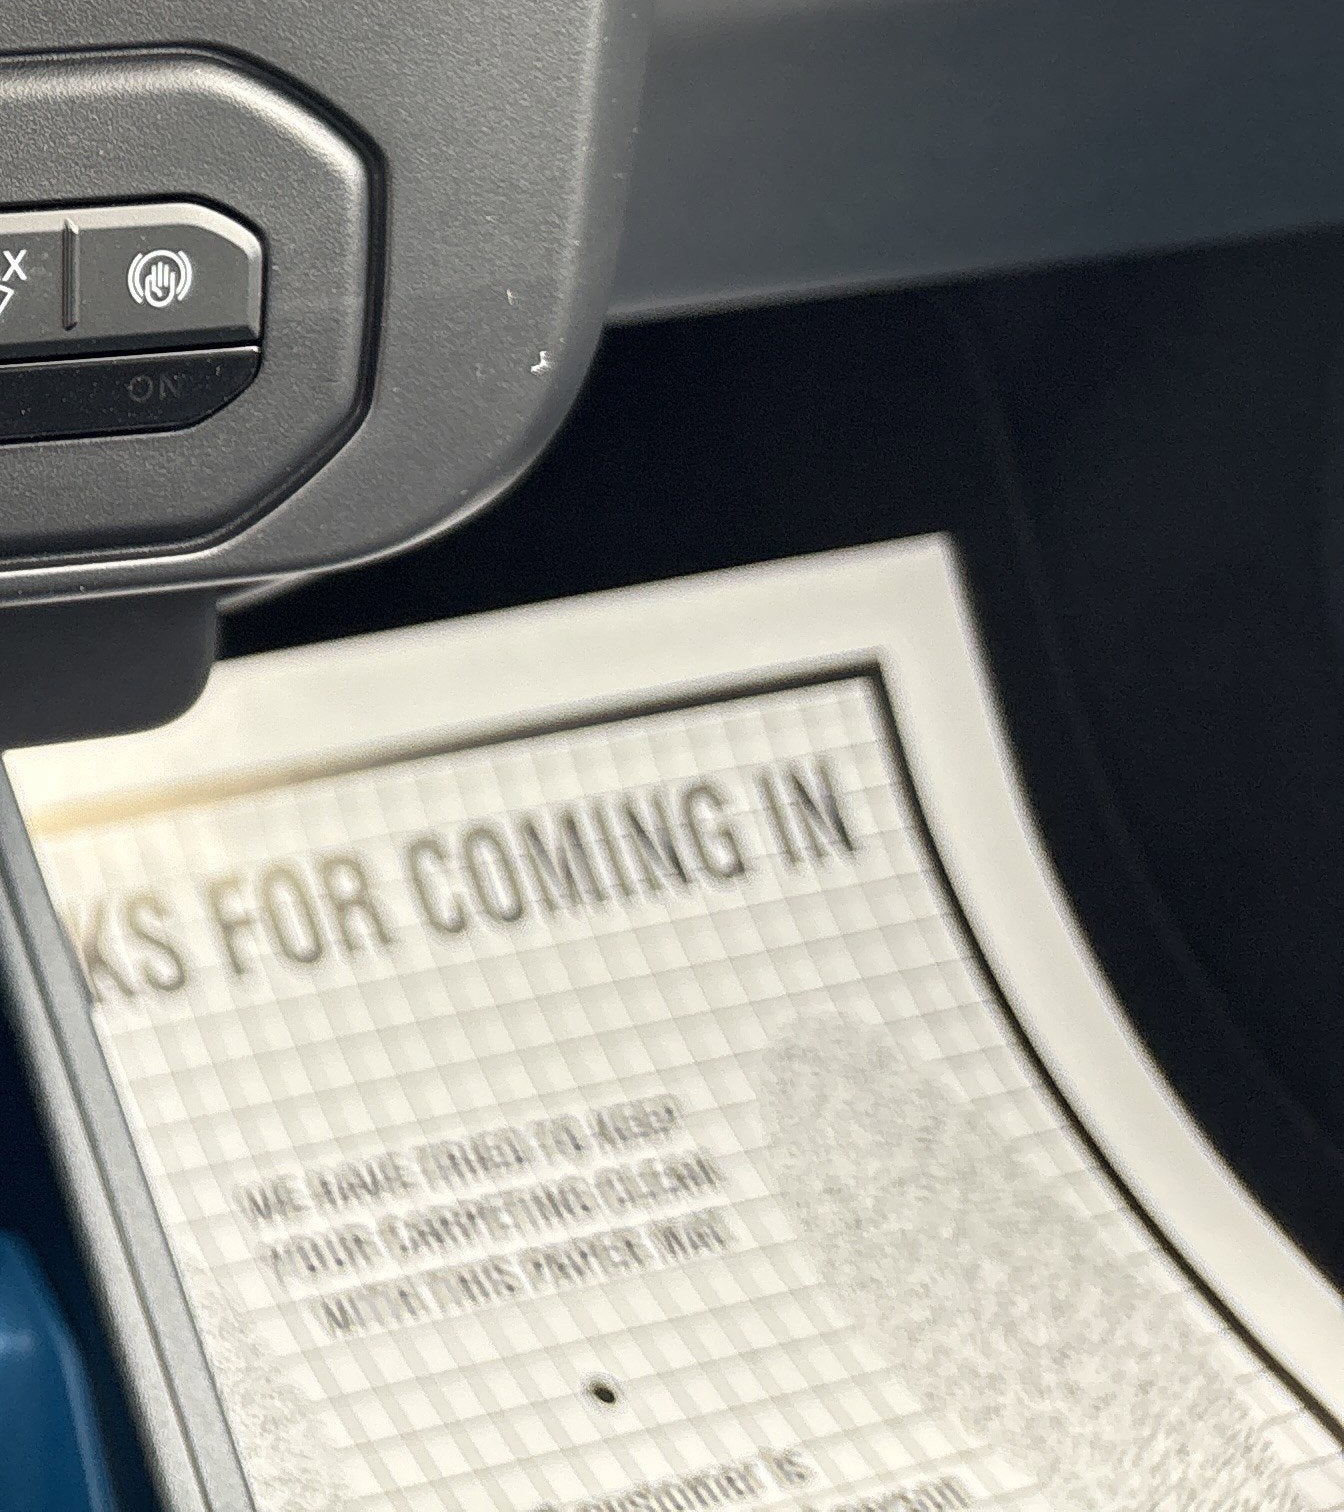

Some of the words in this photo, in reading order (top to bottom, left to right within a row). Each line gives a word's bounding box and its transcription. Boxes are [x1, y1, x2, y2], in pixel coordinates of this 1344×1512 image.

[205, 850, 396, 979] FOR
[403, 782, 746, 935] COMING
[756, 752, 860, 873] IN
